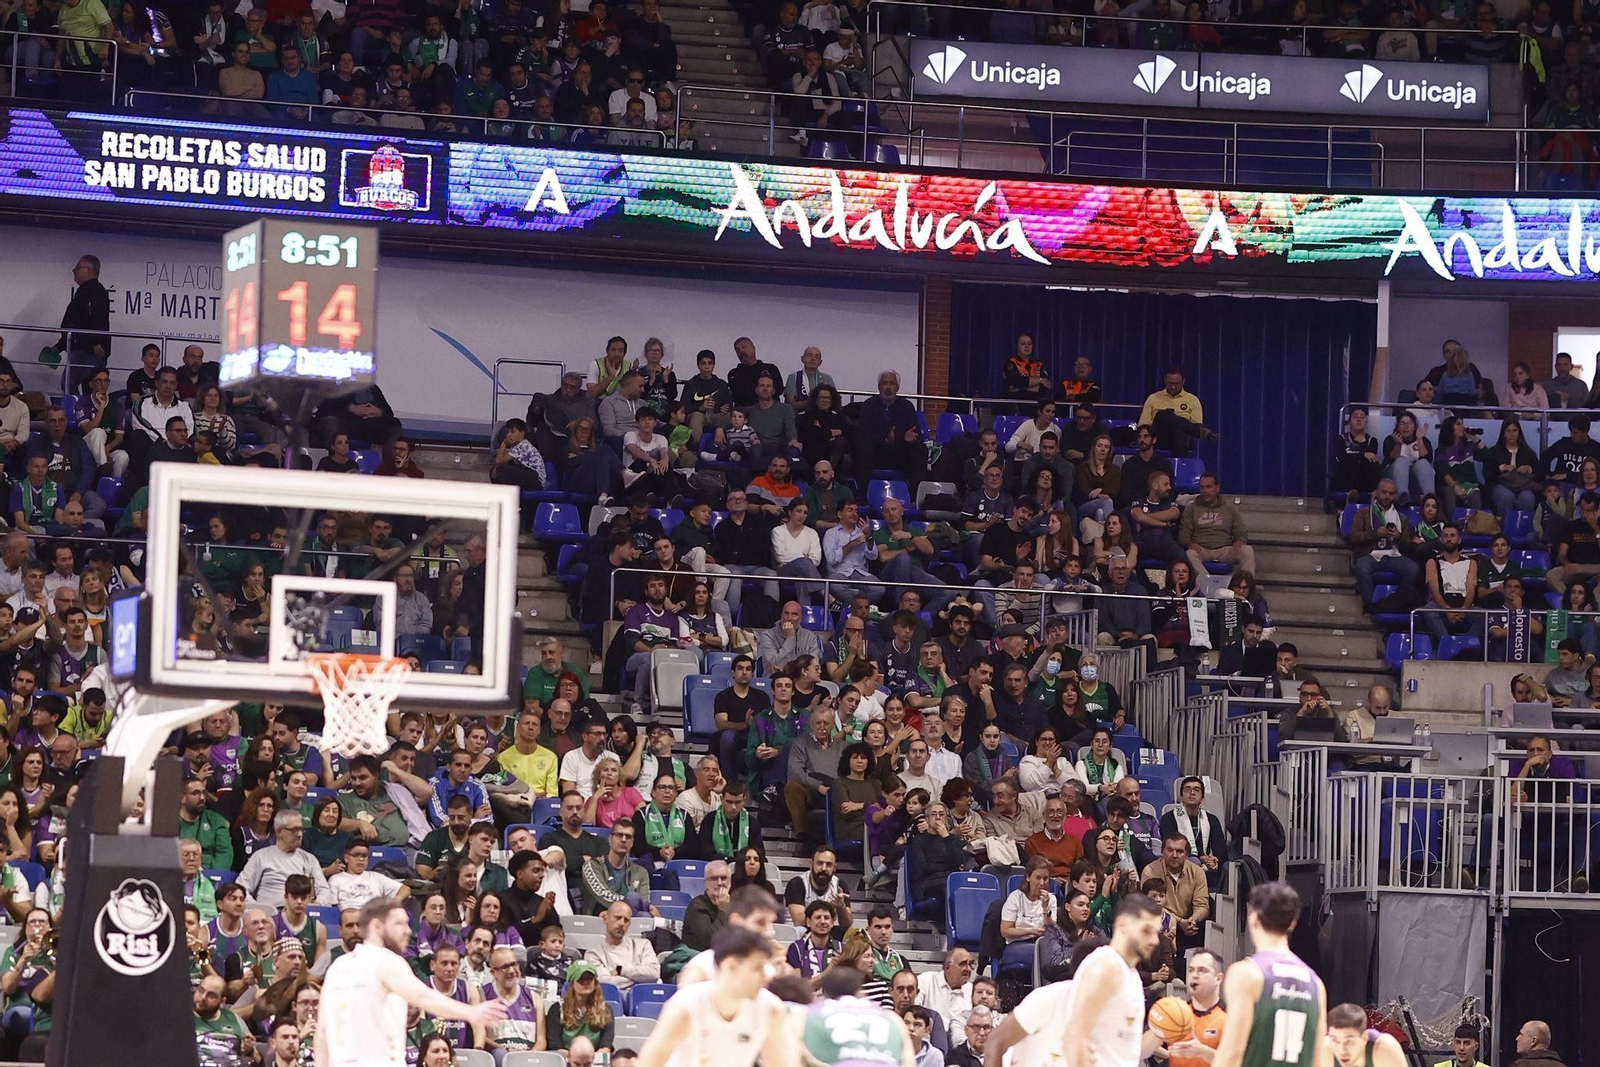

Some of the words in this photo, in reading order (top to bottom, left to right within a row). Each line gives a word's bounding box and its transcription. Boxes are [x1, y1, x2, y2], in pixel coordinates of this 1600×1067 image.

[971, 60, 1061, 91] Unicaja
[1180, 69, 1271, 100] Unicaja
[1387, 79, 1476, 109] Unicaja
[102, 131, 242, 166] RECOLETAS
[247, 143, 327, 173] SALUD
[84, 160, 136, 189] SAN
[141, 165, 220, 195] PABLO
[226, 171, 327, 202] BURGOS
[710, 161, 1052, 266] Andalucía
[280, 231, 358, 268] 8:51
[145, 261, 223, 291] PALACIO
[277, 280, 363, 349] 14
[106, 932, 160, 968] Risi
